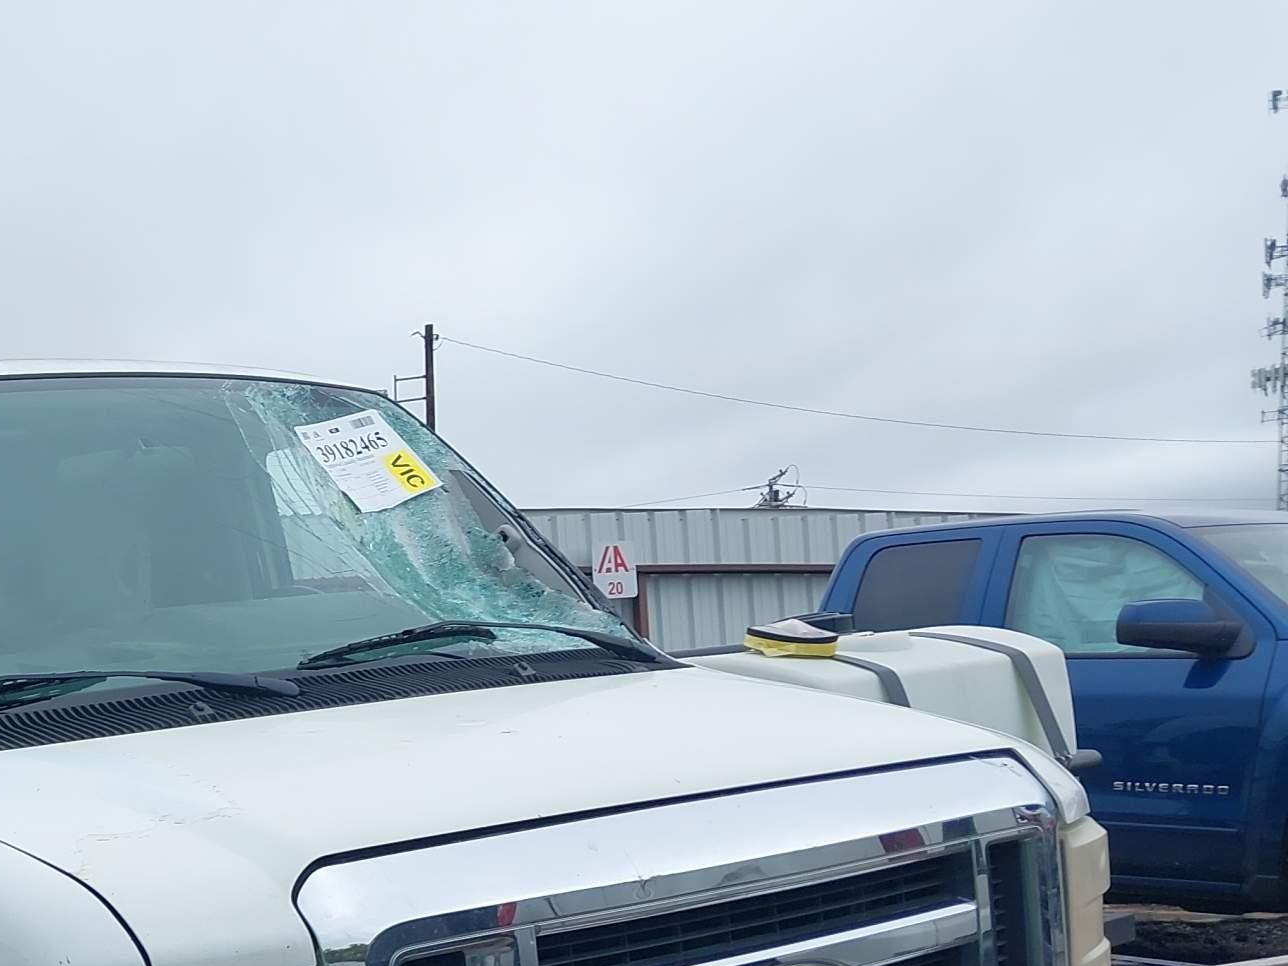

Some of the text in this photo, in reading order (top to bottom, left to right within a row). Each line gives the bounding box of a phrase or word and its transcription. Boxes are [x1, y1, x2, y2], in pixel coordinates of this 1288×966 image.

[316, 432, 388, 463] 39182465
[392, 454, 425, 488] VIC
[608, 582, 623, 595] 20
[1112, 781, 1230, 795] SILVERADO
